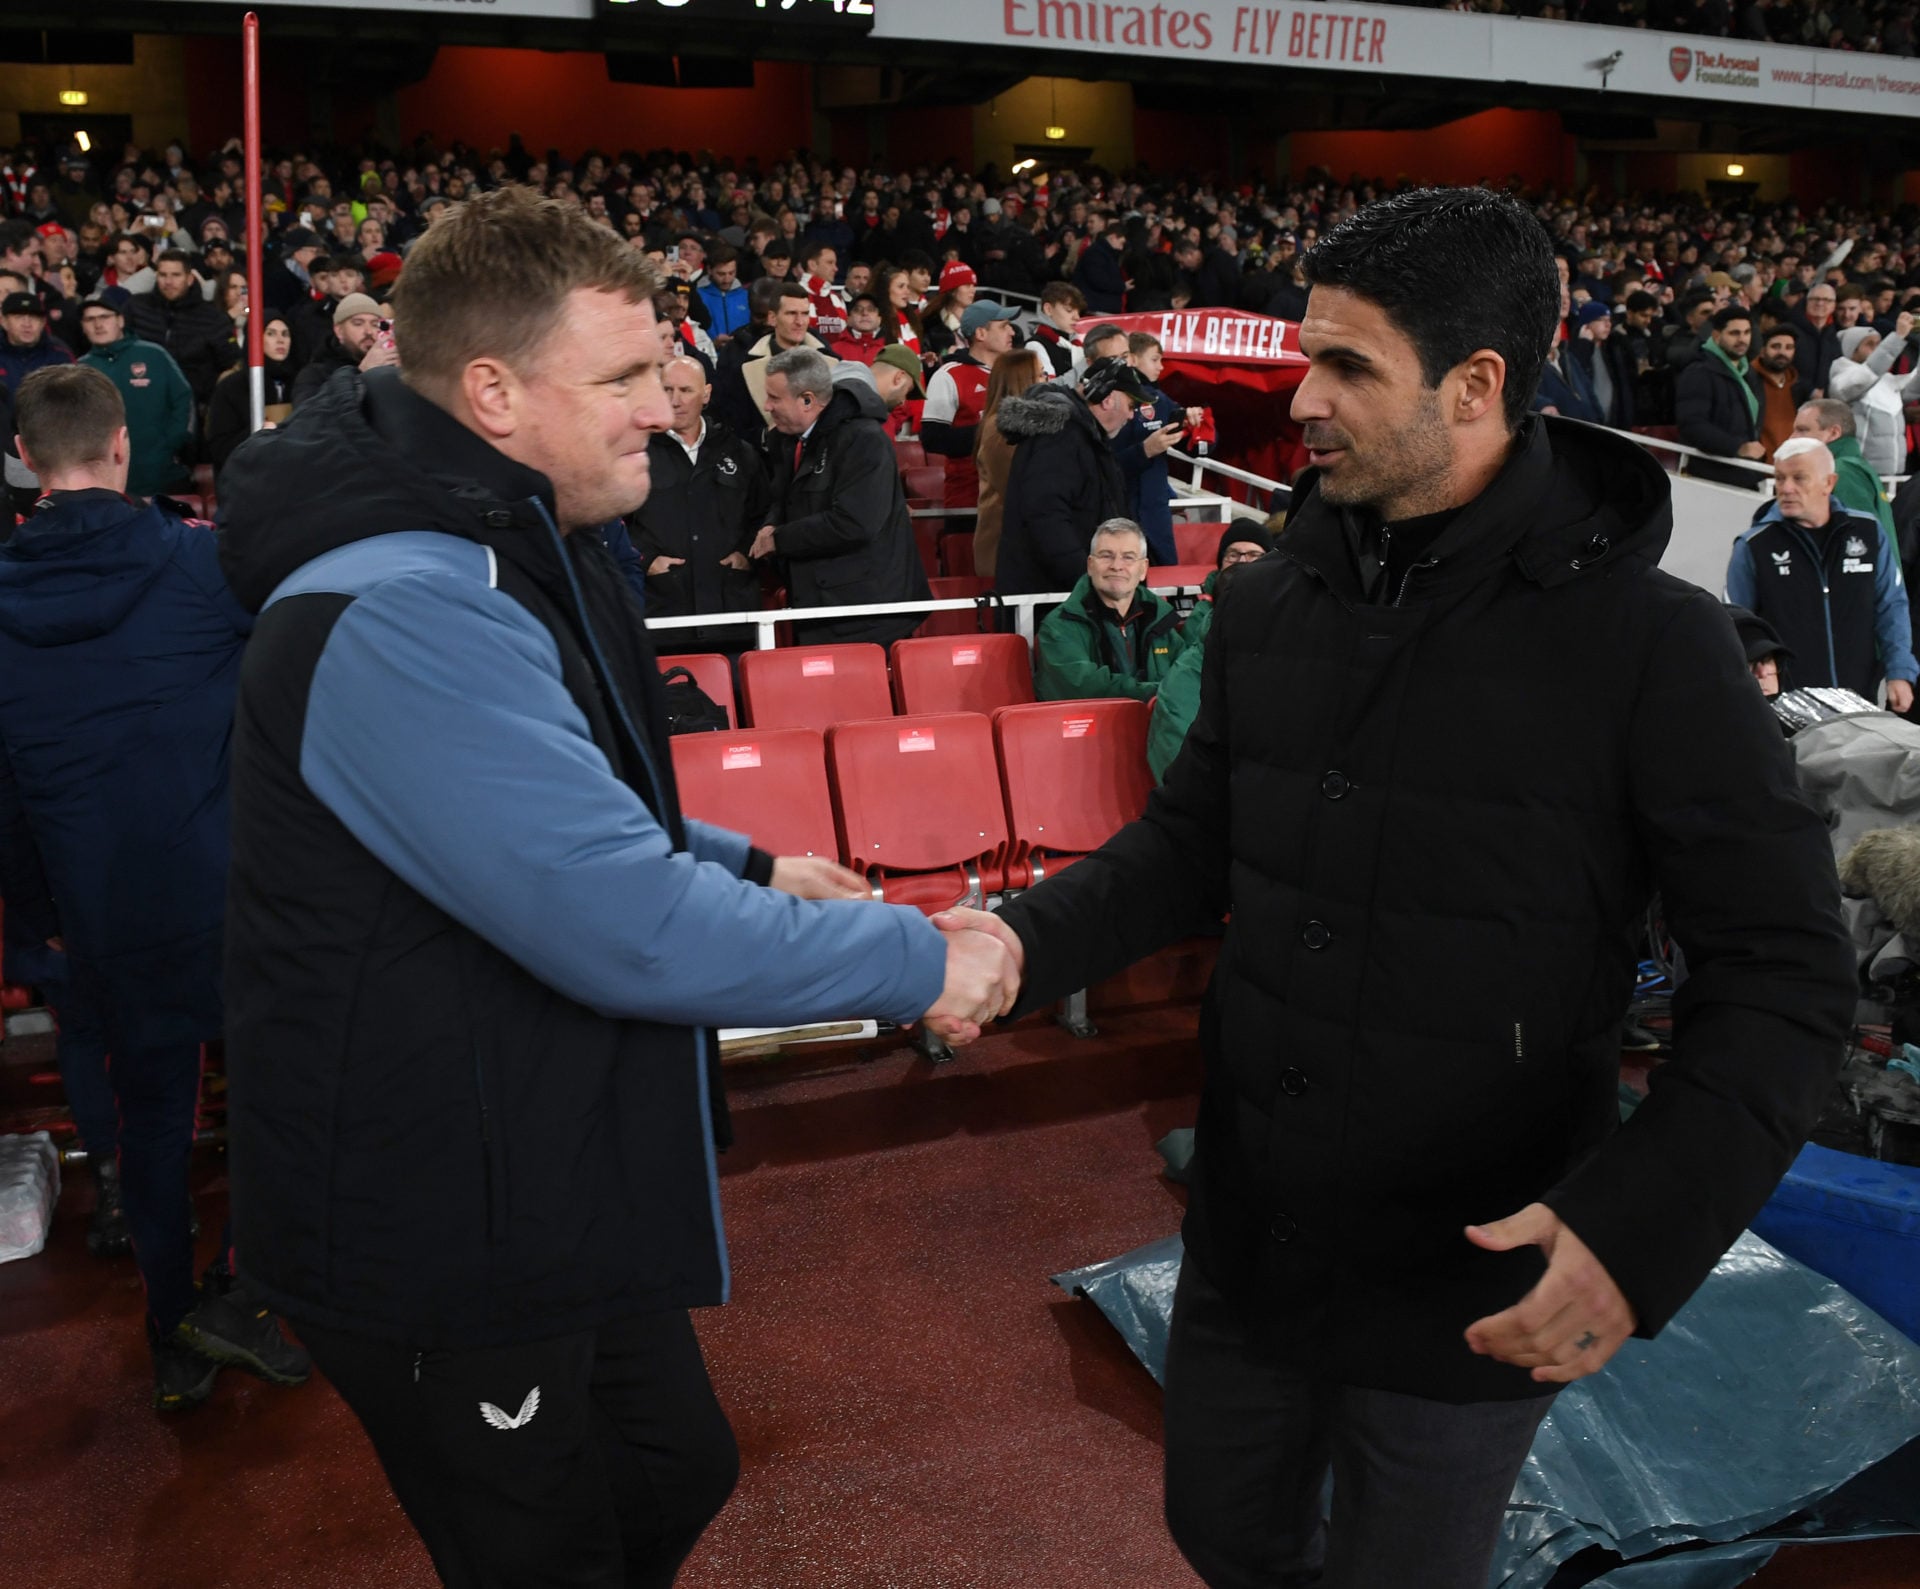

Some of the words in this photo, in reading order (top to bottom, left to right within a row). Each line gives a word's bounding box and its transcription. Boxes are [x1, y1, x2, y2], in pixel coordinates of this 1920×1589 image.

[1003, 0, 1213, 50] Emirates
[1232, 7, 1281, 55] FLY
[1288, 11, 1387, 63] BETTER
[1695, 51, 1716, 67] The
[1717, 54, 1760, 72] Arsenal
[1695, 68, 1760, 88] Foundation
[1160, 312, 1199, 353] FLY
[1203, 315, 1286, 358] BETTER
